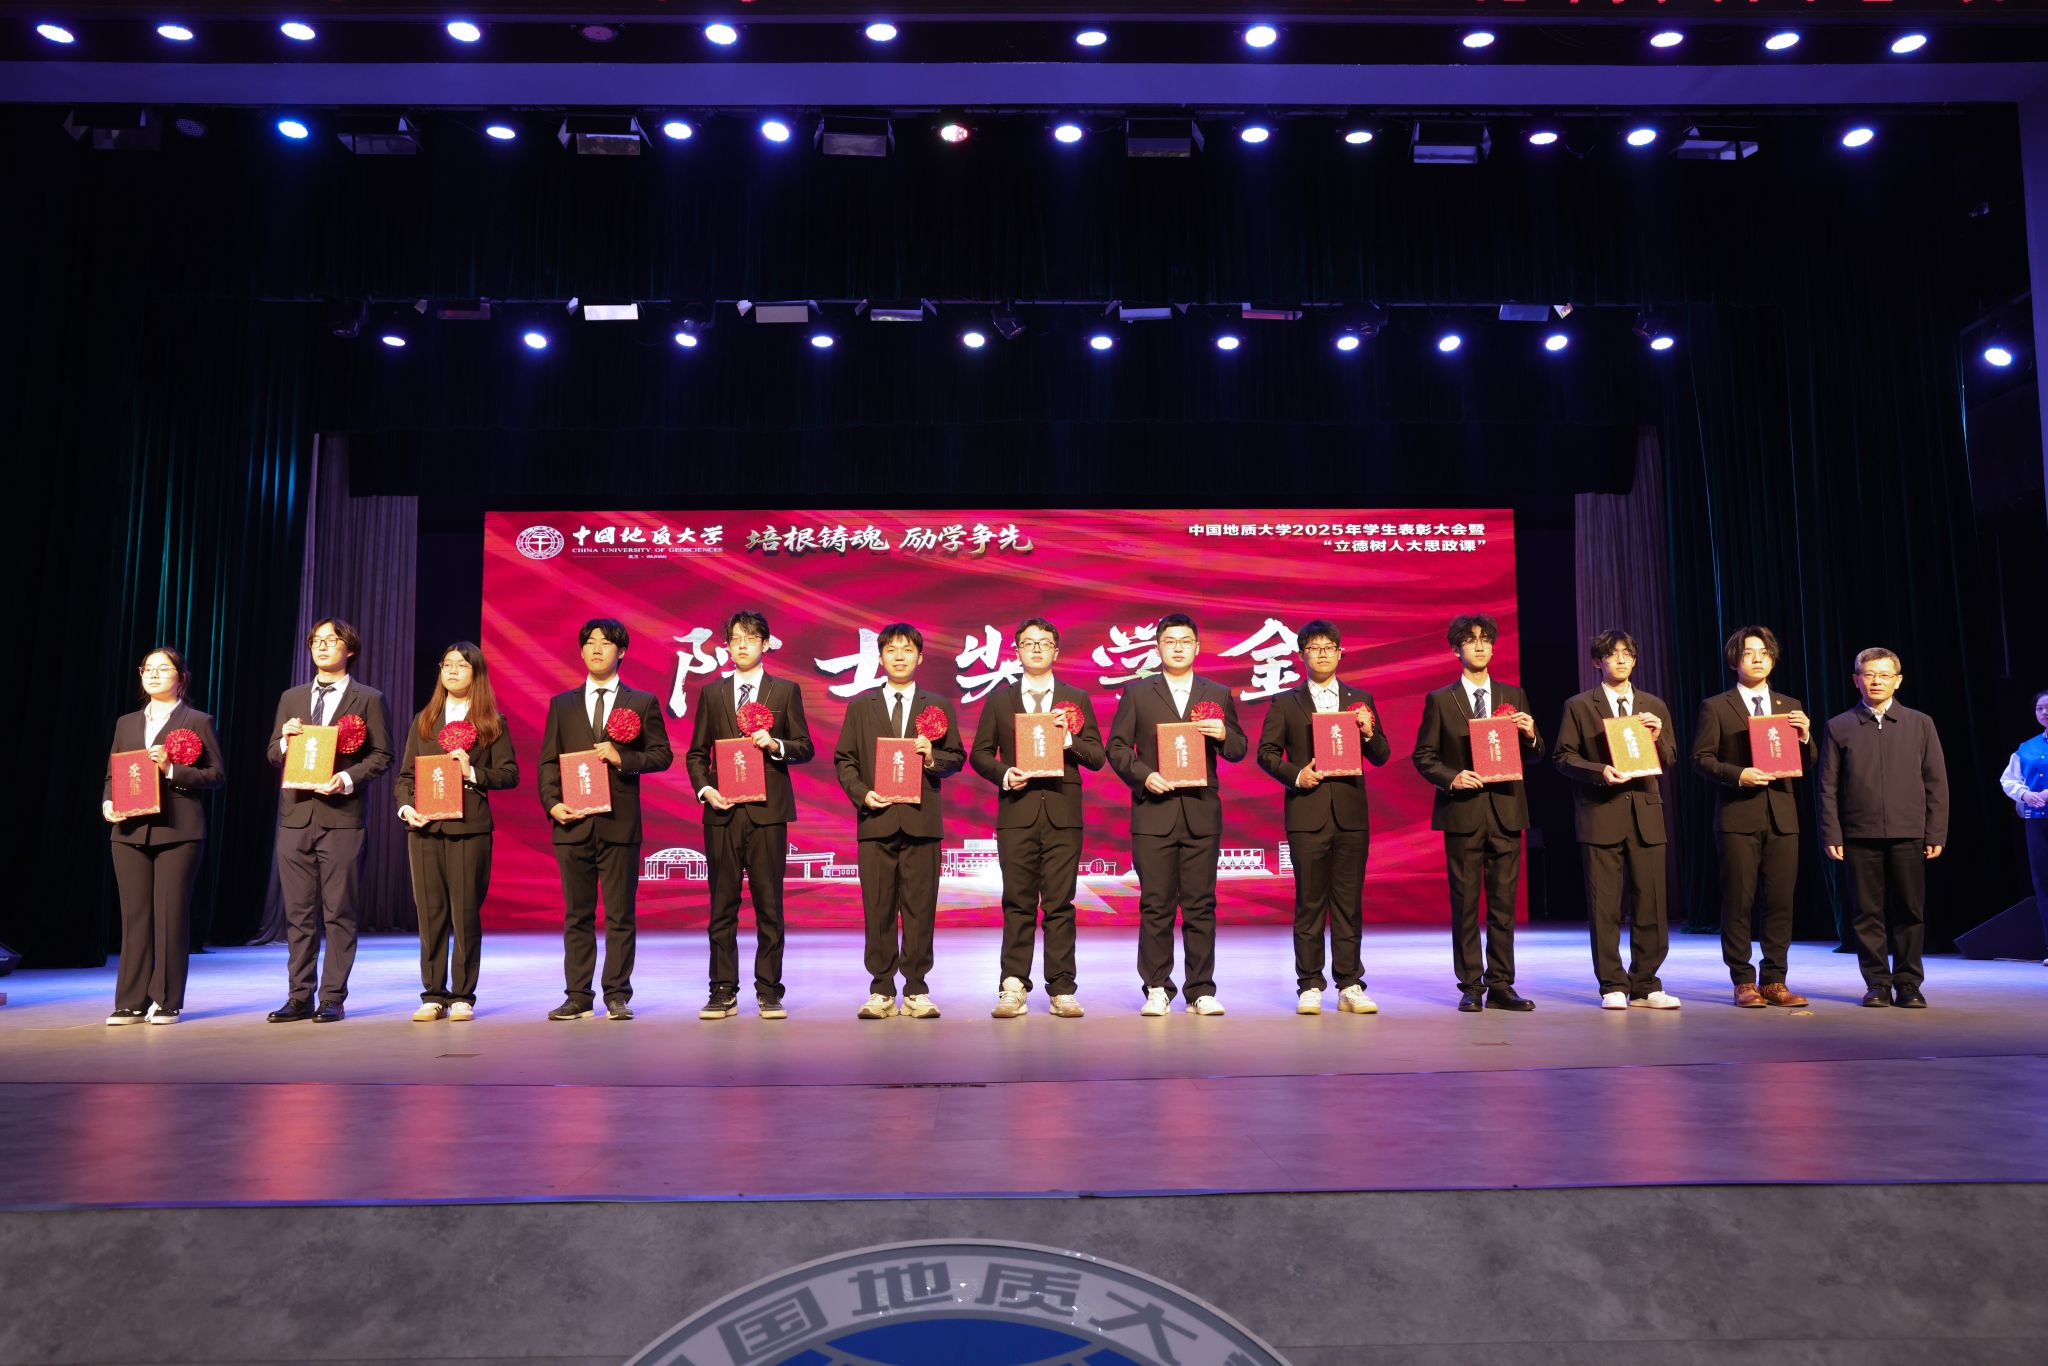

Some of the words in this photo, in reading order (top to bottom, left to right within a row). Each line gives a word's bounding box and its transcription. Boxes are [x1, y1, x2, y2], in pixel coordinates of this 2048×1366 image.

[744, 524, 890, 553] 培根铸魂
[898, 523, 1034, 554] 励学争先
[1188, 523, 1485, 537] 中国地质大学2025年学生表彰大会暨
[652, 1261, 1252, 1366] 国地质大
